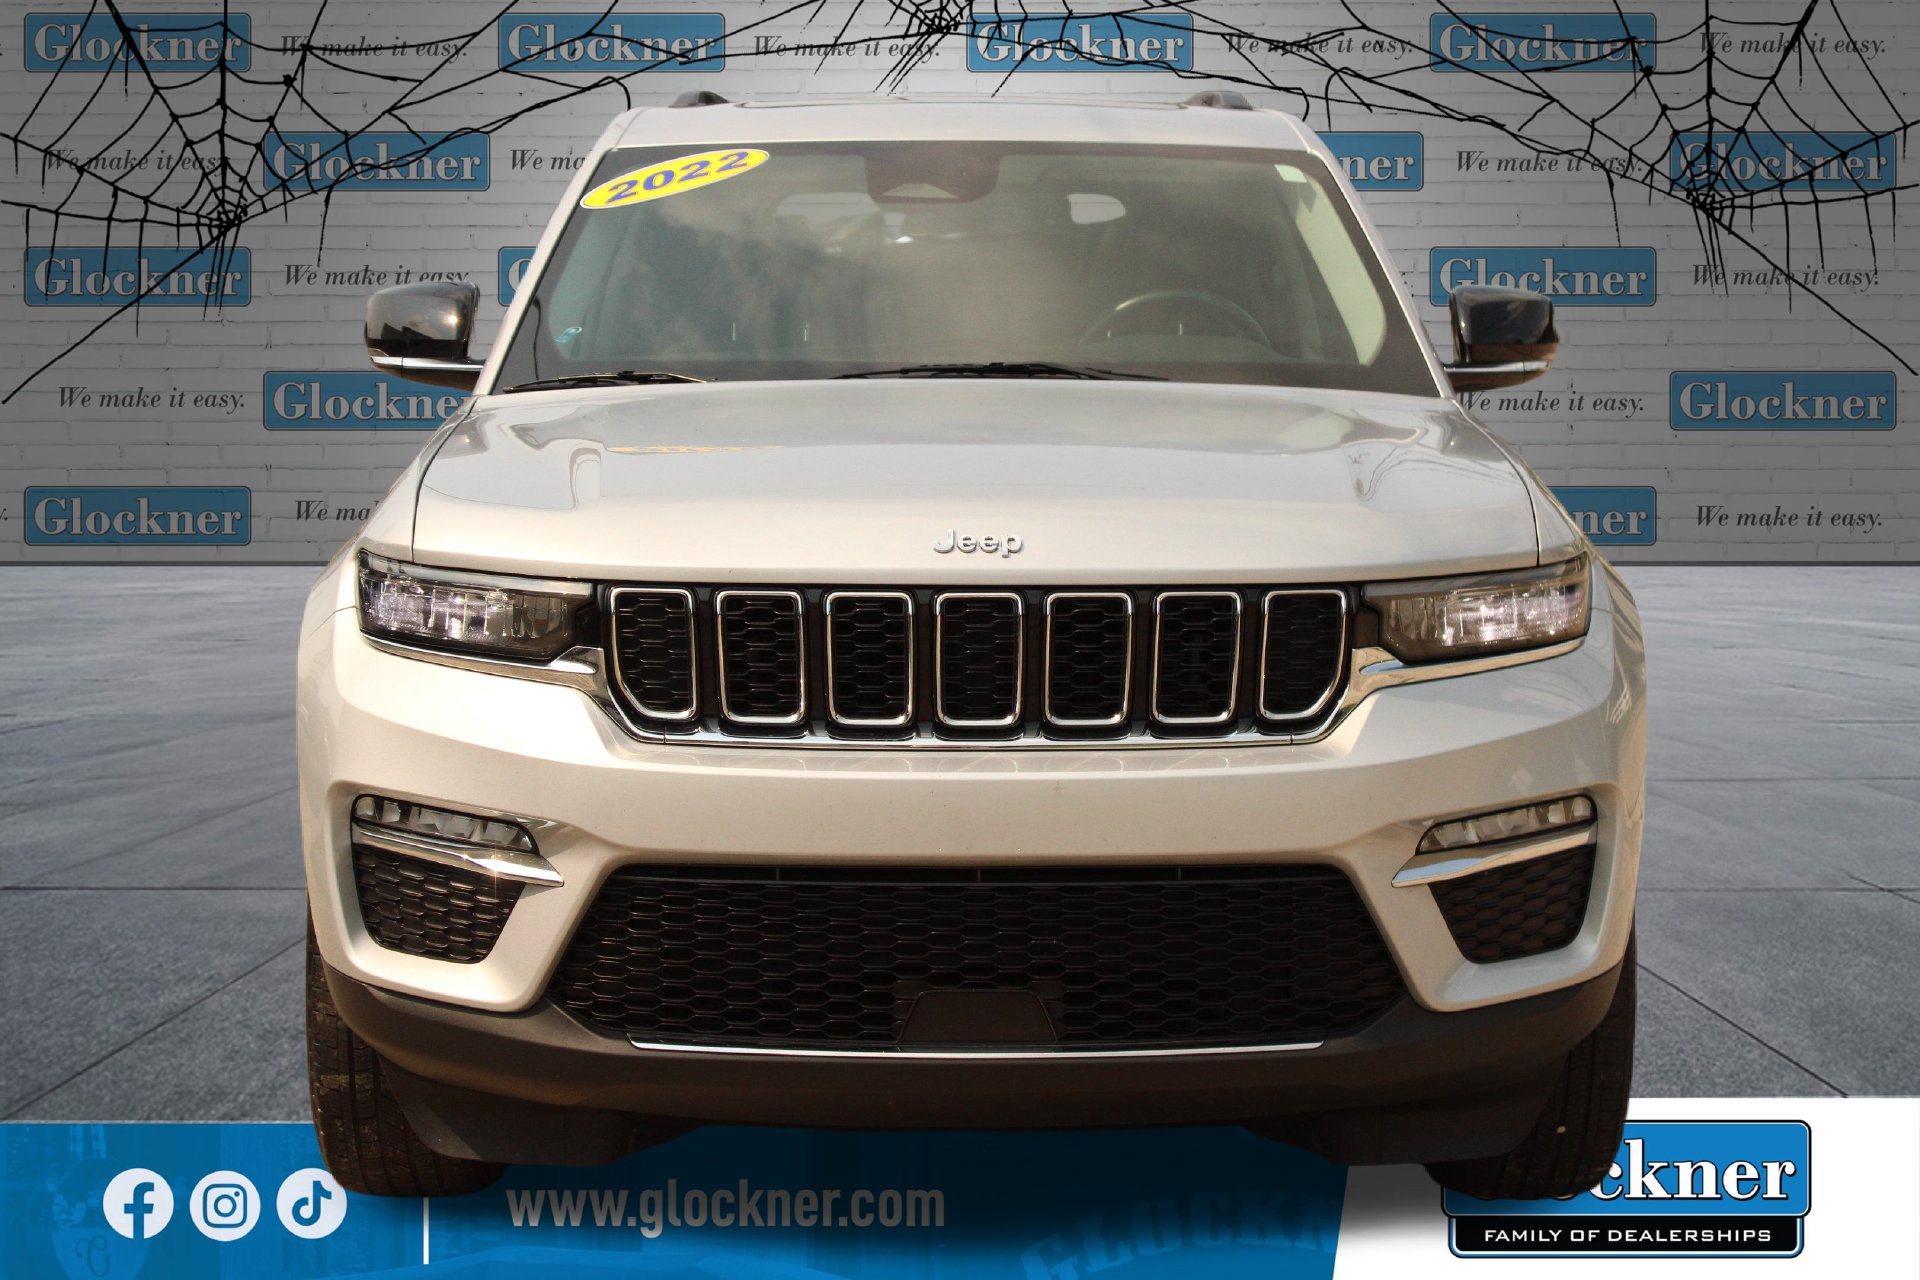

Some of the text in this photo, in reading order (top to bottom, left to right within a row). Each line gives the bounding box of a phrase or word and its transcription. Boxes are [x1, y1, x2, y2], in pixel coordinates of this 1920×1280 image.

[34, 24, 242, 63] Glockner
[280, 35, 314, 57] We
[321, 35, 383, 57] make
[391, 36, 408, 57] it
[508, 24, 716, 63] Glockner
[753, 35, 787, 57] We
[794, 35, 856, 57] make
[864, 36, 881, 57] it
[976, 24, 1184, 63] Glockner
[1226, 32, 1260, 54] We
[1267, 32, 1329, 54] make
[1337, 33, 1354, 54] it
[1440, 24, 1648, 63] Glockner
[1699, 31, 1733, 53] We
[1740, 31, 1802, 53] make
[1810, 32, 1827, 53] it
[87, 148, 149, 170] make
[157, 149, 174, 170] it
[273, 143, 481, 182] Glockner
[511, 150, 586, 170] We ma
[1455, 150, 1489, 172] We
[1496, 150, 1558, 172] make
[1566, 151, 1583, 172] it
[1680, 143, 1888, 182] Glockner
[604, 151, 750, 205] 2022
[34, 258, 242, 297] Glockner
[284, 264, 318, 286] We
[325, 264, 387, 286] make
[395, 265, 412, 286] it
[1692, 264, 1726, 286] We
[1733, 264, 1795, 286] make
[1803, 265, 1820, 286] it
[58, 386, 245, 415] We make it easy.
[273, 382, 473, 421] Glockne
[1498, 390, 1560, 412] make
[1568, 391, 1585, 412] it
[1680, 382, 1888, 421] Glockner
[34, 497, 242, 536] Glockner
[296, 501, 376, 520] We ma
[1695, 505, 1882, 534] We make it easy.
[932, 528, 1024, 558] Jeep
